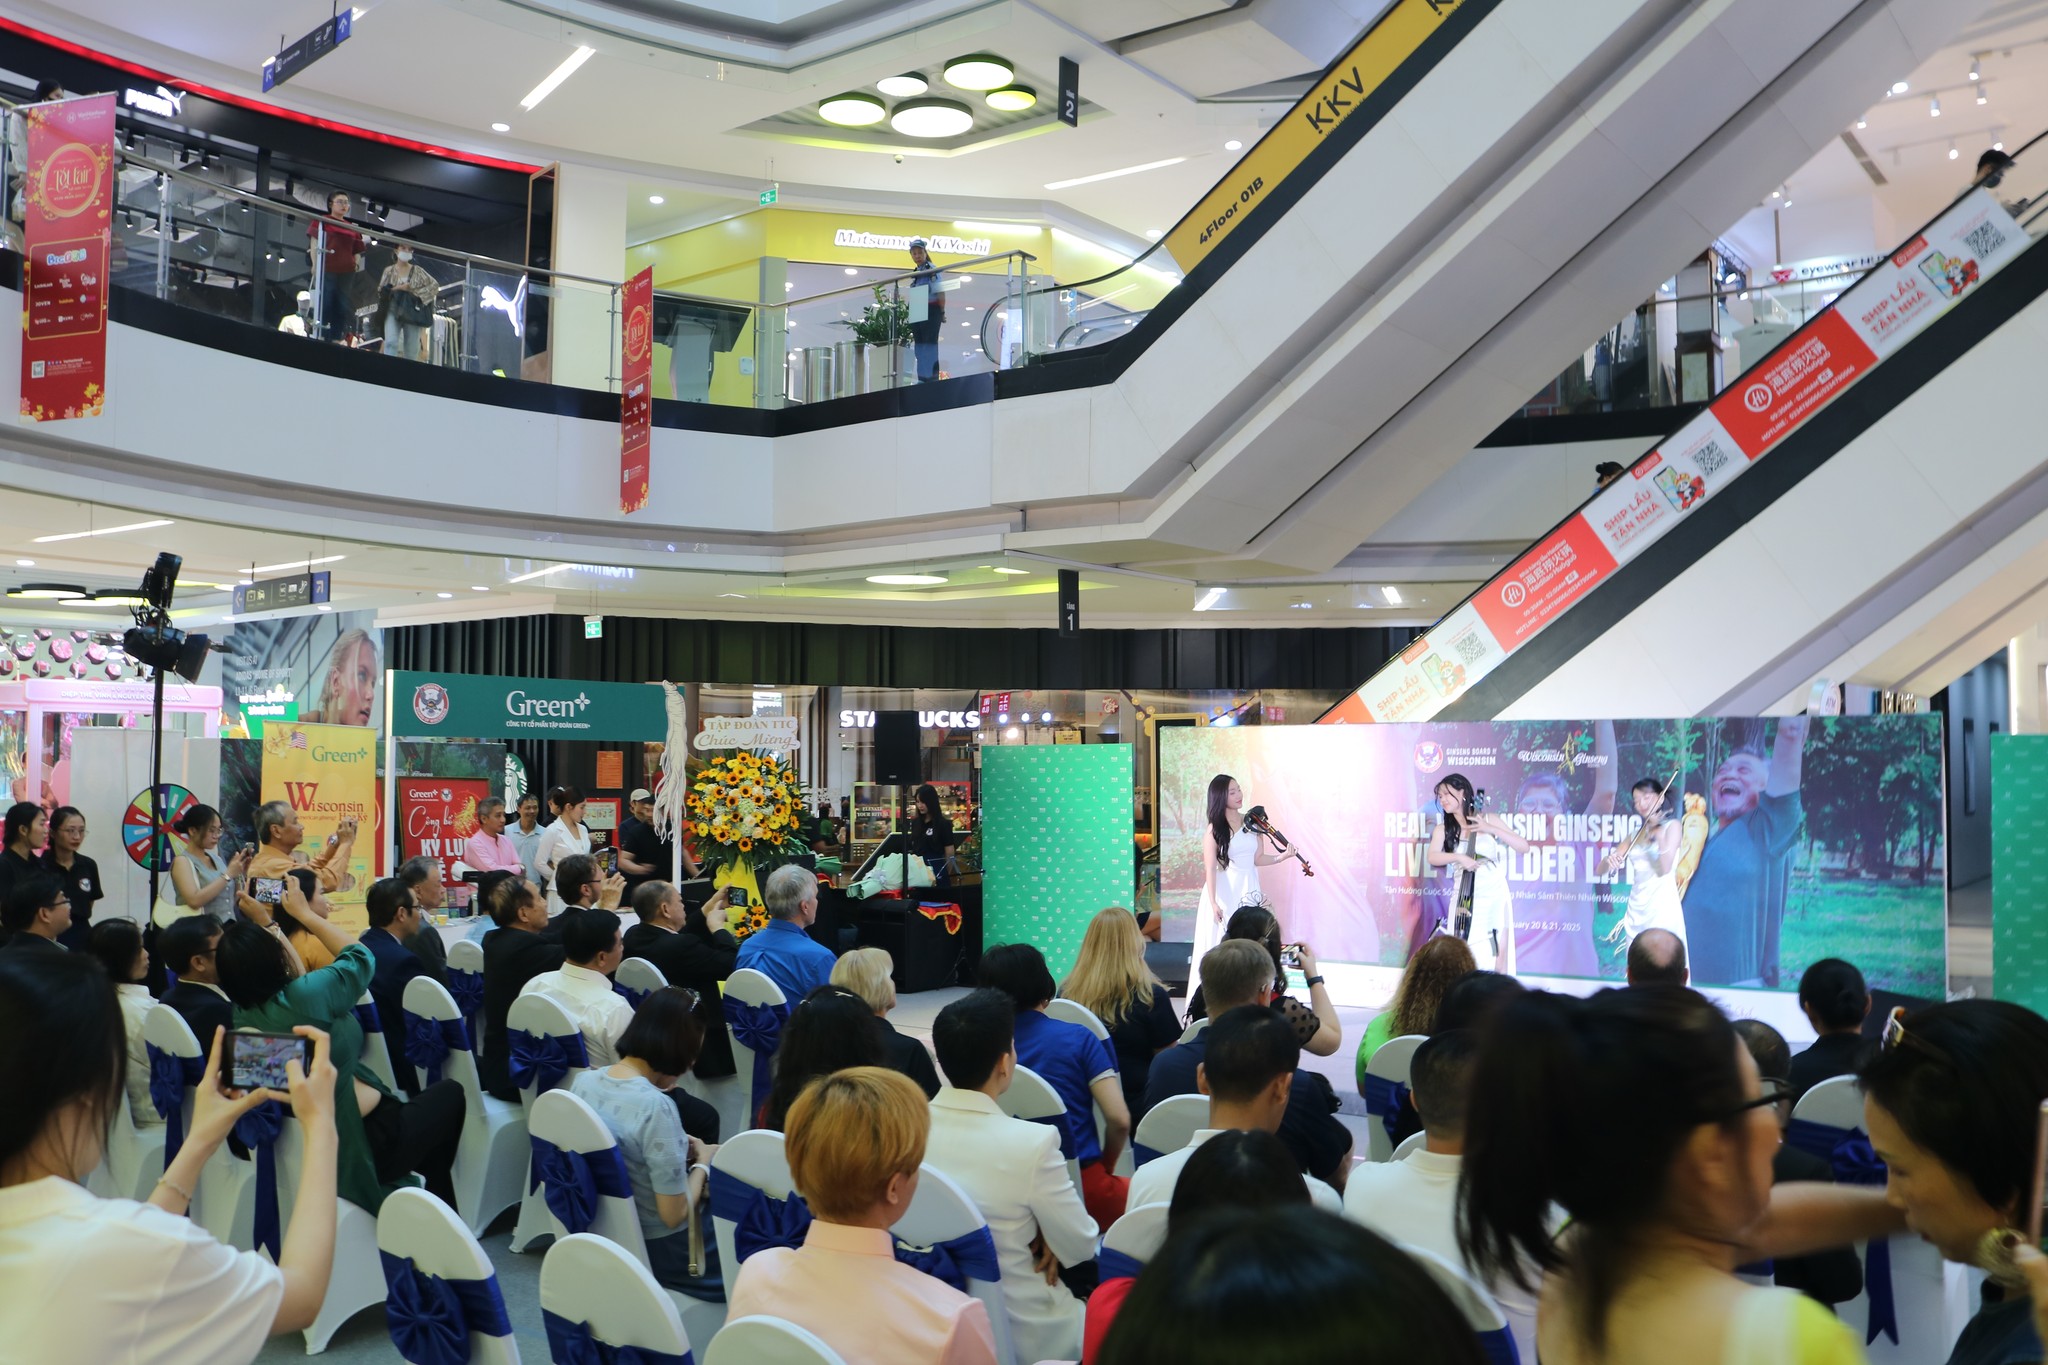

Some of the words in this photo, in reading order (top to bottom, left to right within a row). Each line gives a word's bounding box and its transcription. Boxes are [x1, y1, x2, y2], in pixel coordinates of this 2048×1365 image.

[1066, 100, 1074, 118] 2
[1240, 176, 1264, 203] 01B
[1860, 297, 1889, 325] SHIP
[1602, 508, 1628, 531] SHIP
[1068, 614, 1073, 630] 1
[1376, 690, 1399, 711] SHIP
[708, 720, 731, 732] TẬP
[734, 718, 768, 730] ĐOÀN
[772, 720, 793, 729] TTC
[840, 710, 980, 728] STAUCKS
[698, 734, 737, 746] Chúc
[742, 734, 796, 749] Mừng
[1446, 748, 1470, 756] GINSENG
[1447, 756, 1496, 766] WISCONSIN
[1572, 752, 1608, 766] Ginseng
[284, 782, 364, 812] Wisconsin
[1384, 812, 1430, 838] REAL
[445, 839, 470, 860] LỤ
[1602, 894, 1630, 903] Wiscon
[1562, 923, 1581, 932] 2025
